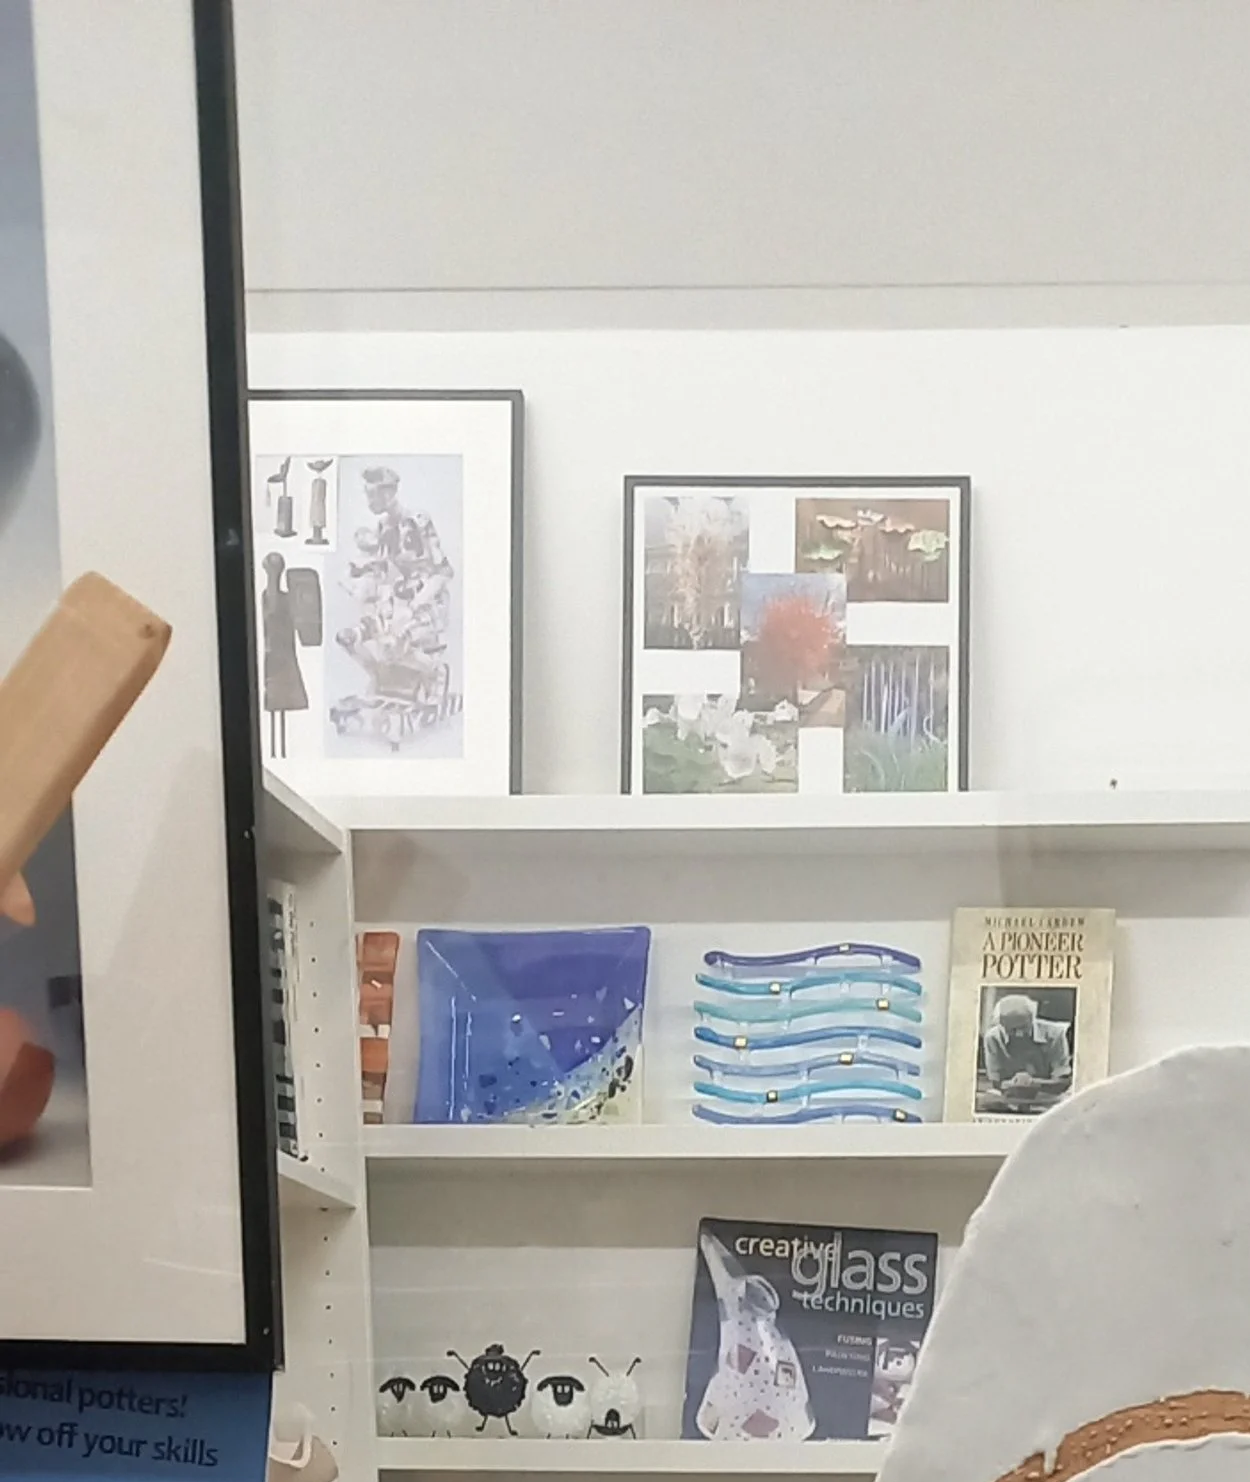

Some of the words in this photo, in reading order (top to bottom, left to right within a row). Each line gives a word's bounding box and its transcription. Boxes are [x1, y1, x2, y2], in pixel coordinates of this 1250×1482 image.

[983, 931, 995, 951] A
[1001, 931, 1084, 952] PIONEER
[982, 953, 1083, 979] POTTER
[735, 1235, 835, 1262] creative
[791, 1232, 927, 1300] glass
[802, 1291, 925, 1321] techniques
[78, 1386, 189, 1418] potters!
[0, 1422, 32, 1443] w
[36, 1421, 79, 1448] off
[82, 1432, 147, 1458] your
[151, 1435, 219, 1467] skills
